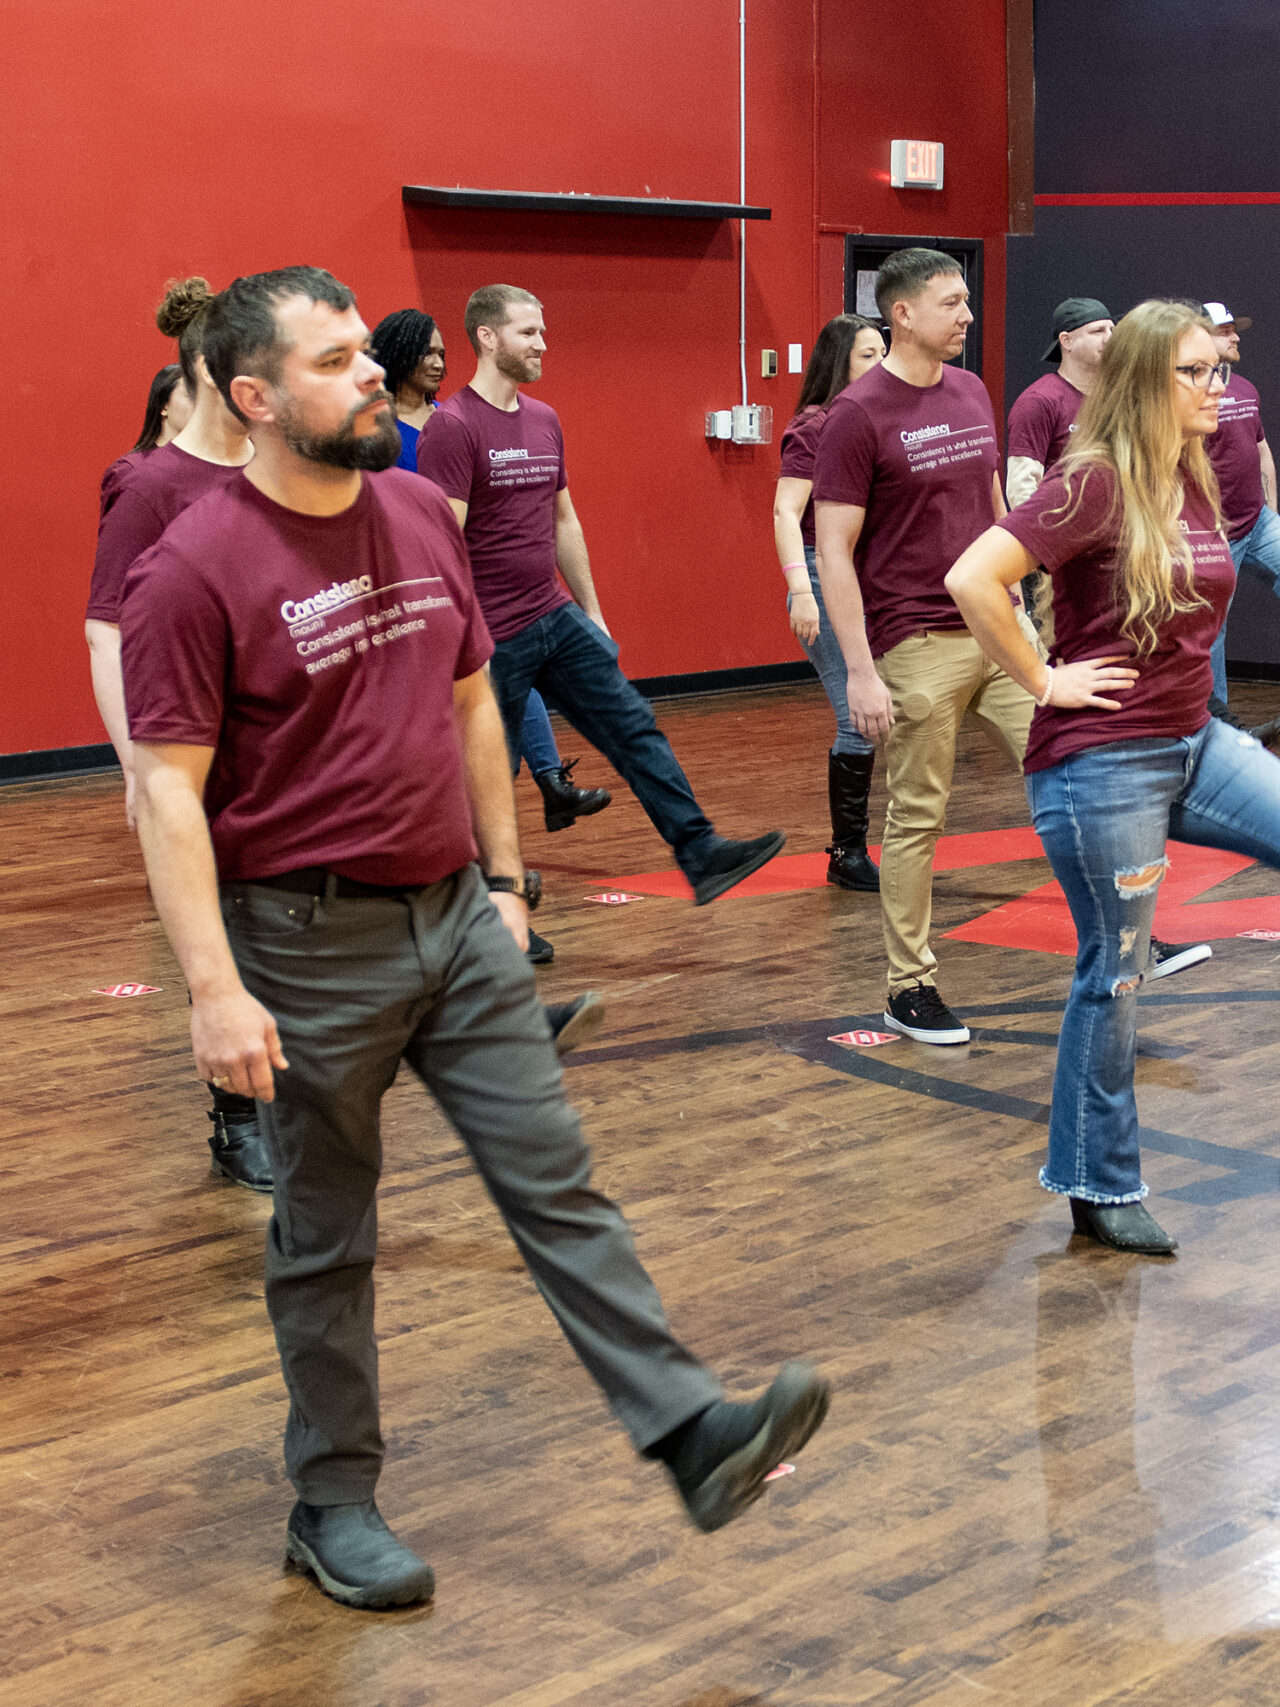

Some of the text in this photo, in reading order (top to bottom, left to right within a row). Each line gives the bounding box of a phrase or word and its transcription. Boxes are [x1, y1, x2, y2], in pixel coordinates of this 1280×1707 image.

[906, 142, 938, 180] EXIT
[900, 423, 950, 443] Consistency
[489, 448, 528, 460] Consistency
[907, 446, 946, 462] Consistency
[910, 459, 938, 473] average
[280, 574, 374, 624] Consistenc
[288, 618, 327, 639] (noun)
[371, 617, 427, 647] ecellence
